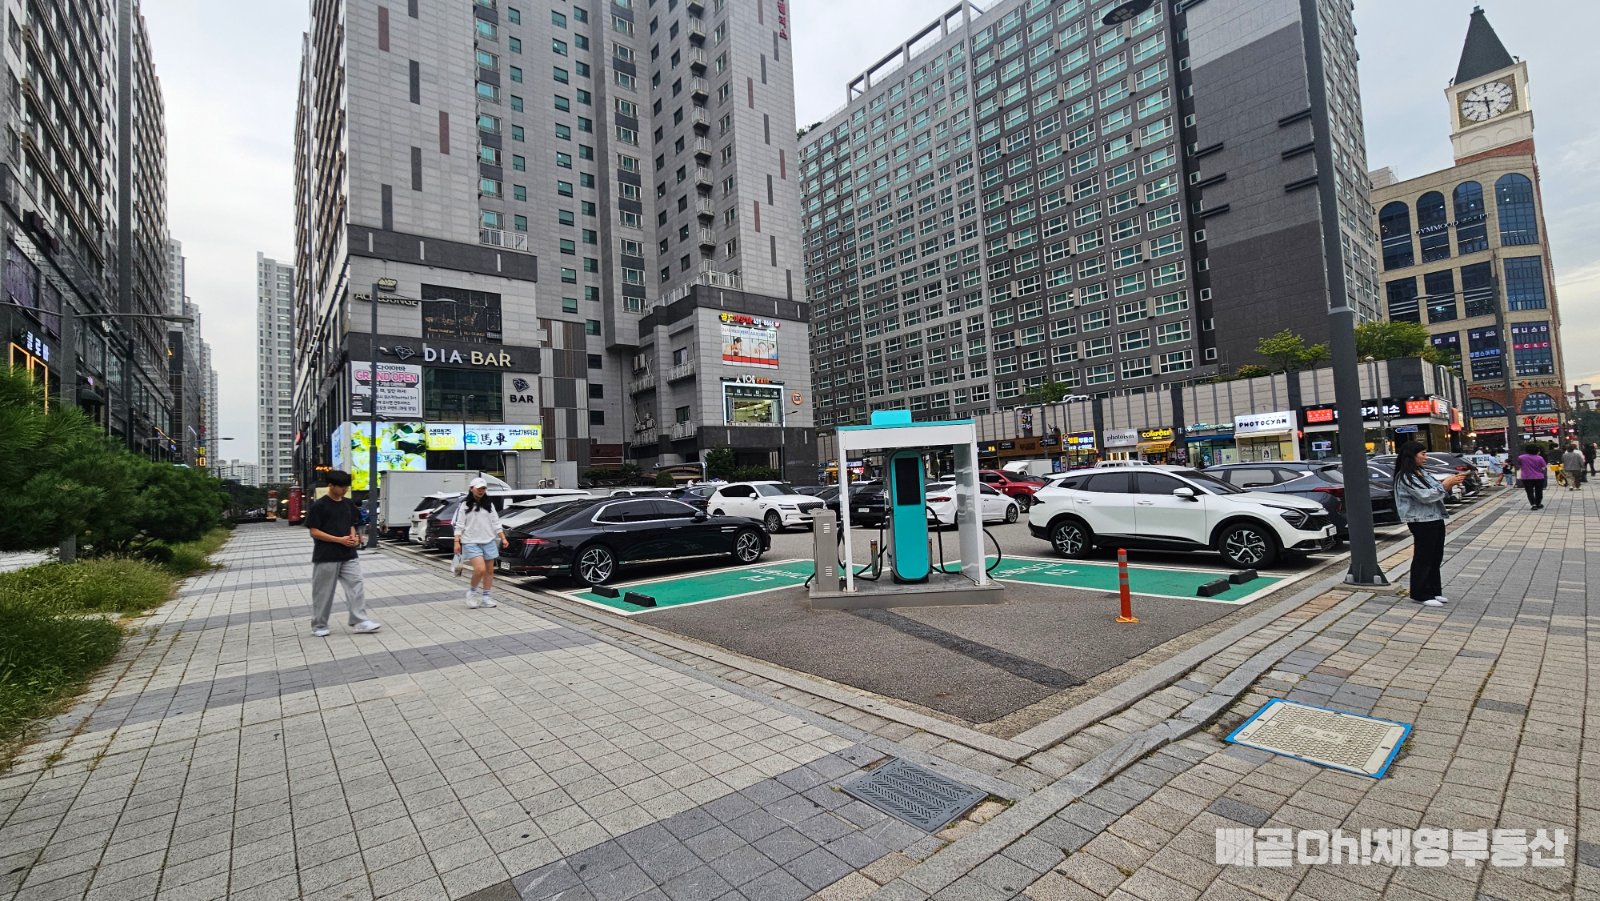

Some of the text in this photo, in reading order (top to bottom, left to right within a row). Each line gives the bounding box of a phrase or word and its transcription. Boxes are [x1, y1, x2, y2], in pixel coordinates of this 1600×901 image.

[424, 347, 512, 368] DIA BAR
[356, 370, 417, 383] GRND OPEN
[509, 394, 534, 404] BAR
[1238, 418, 1287, 428] PHOTOCYAN
[1106, 433, 1135, 442] photoism
